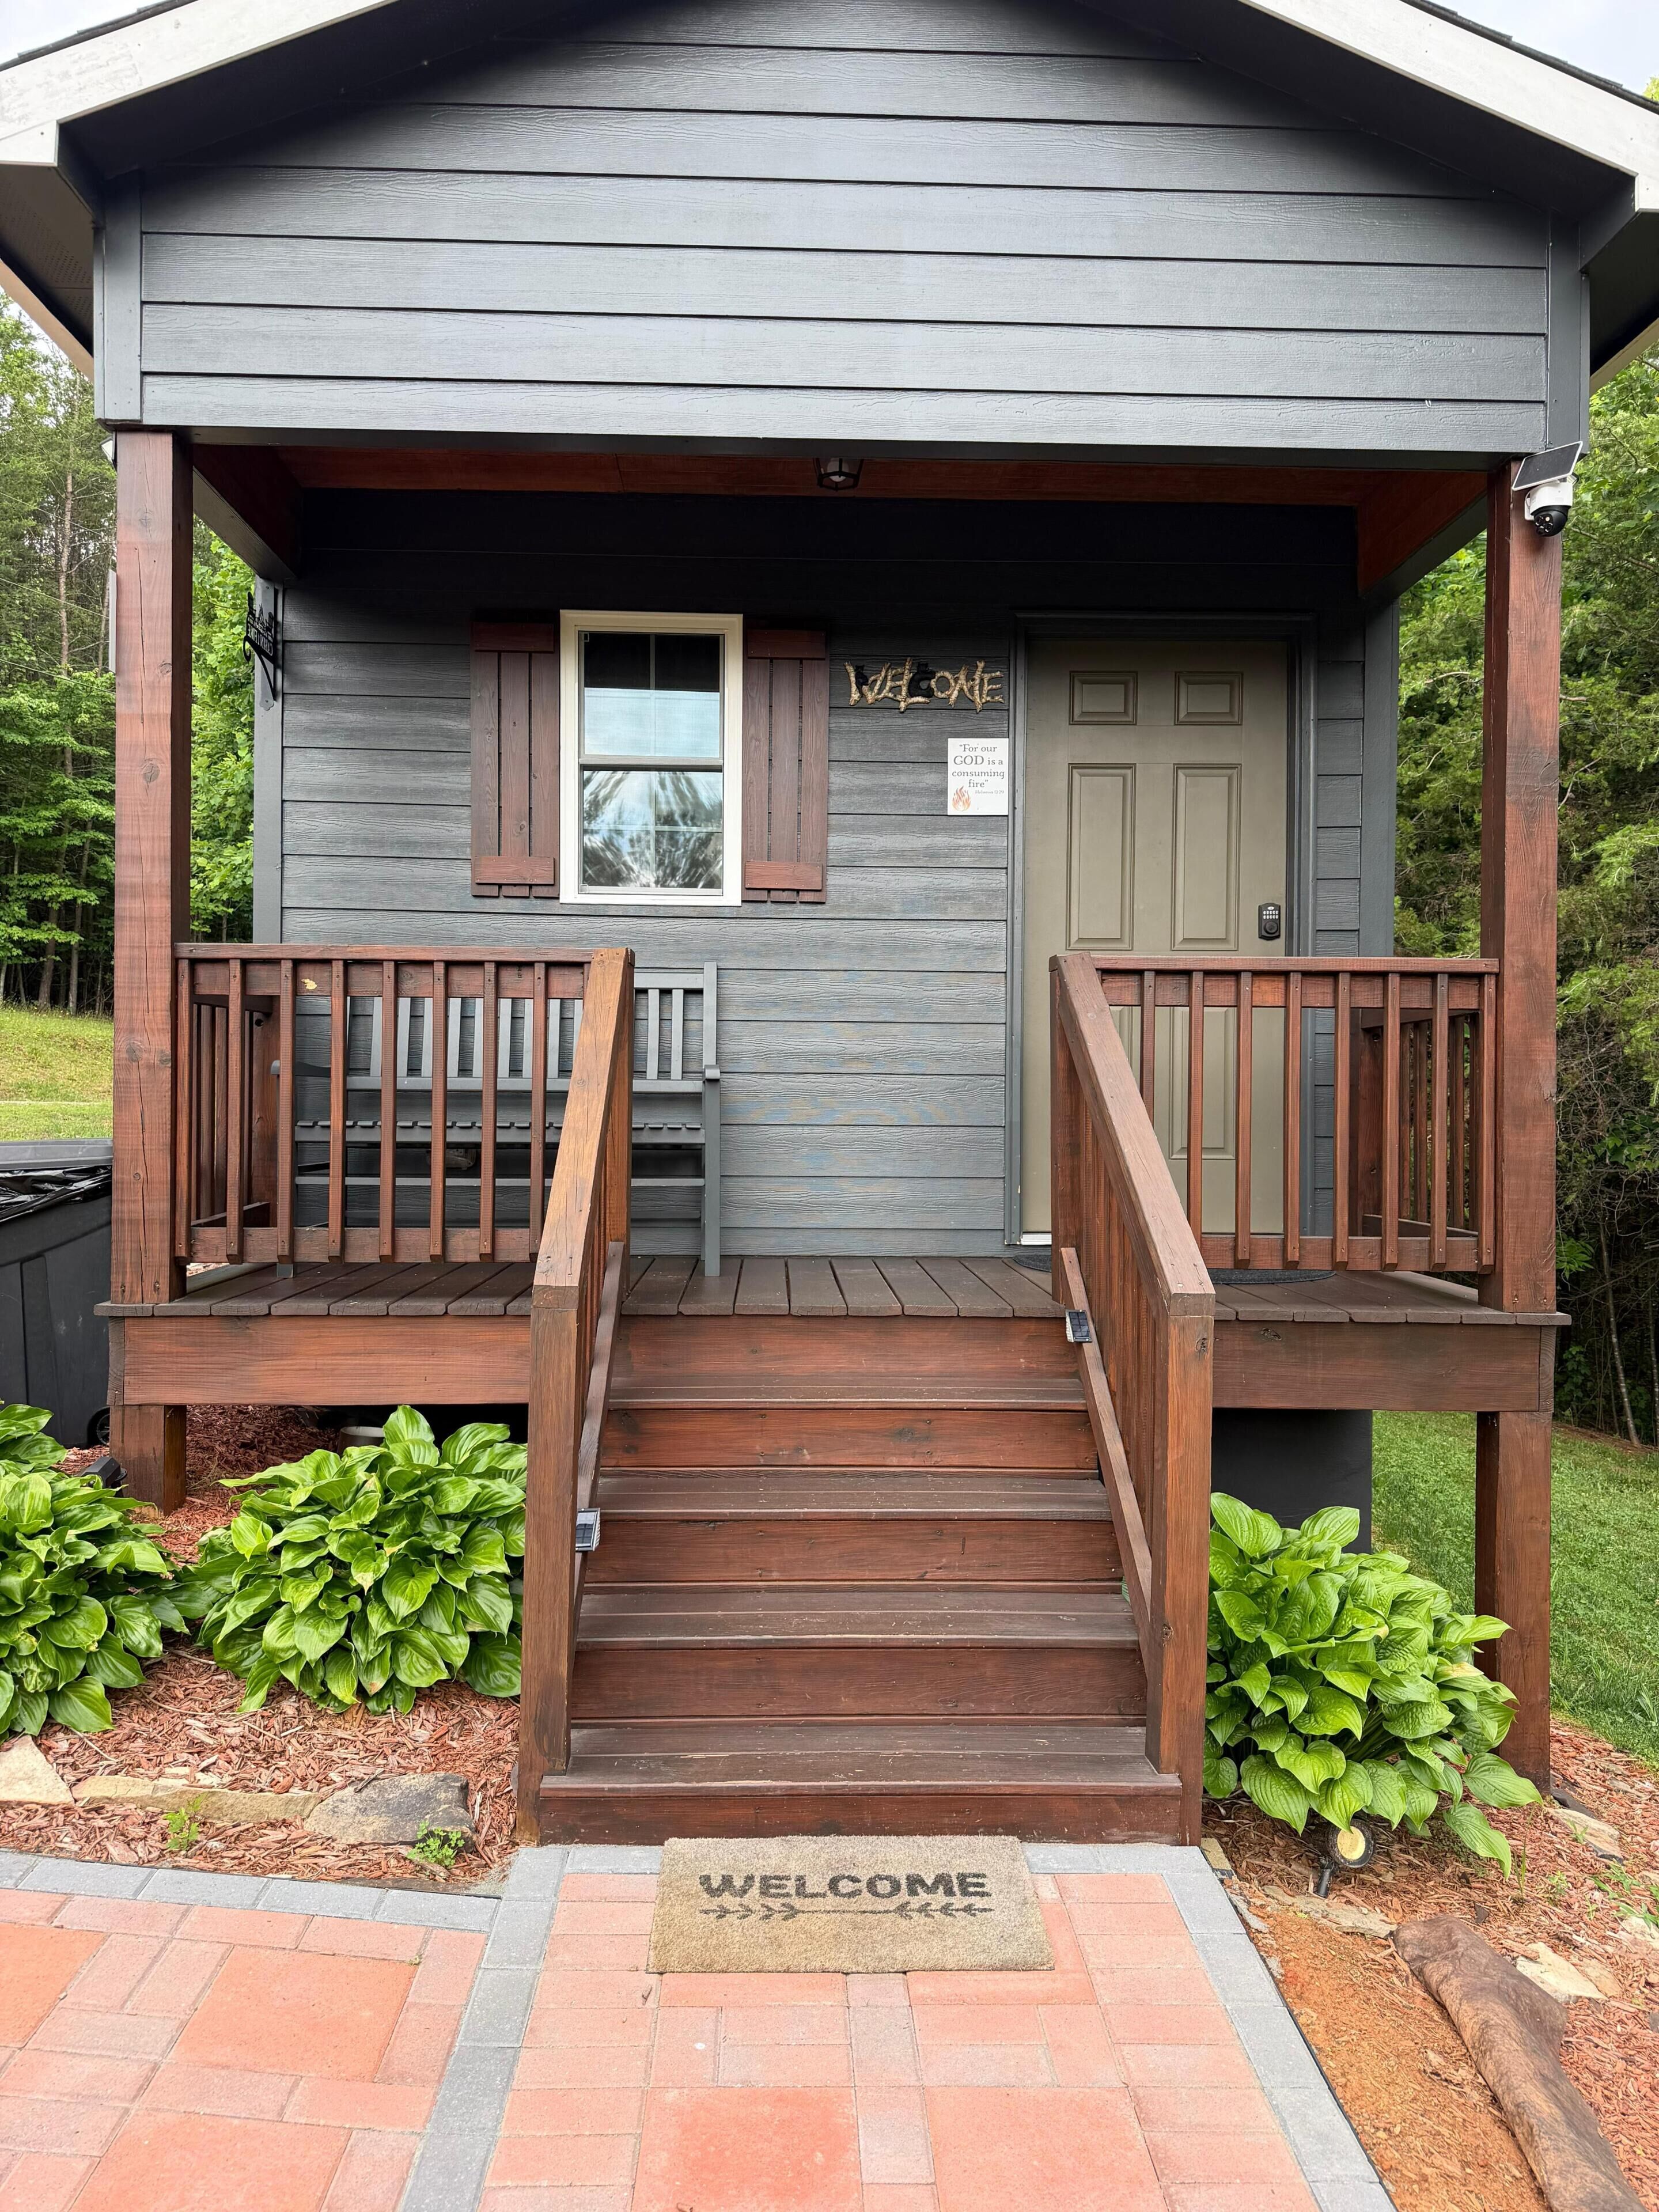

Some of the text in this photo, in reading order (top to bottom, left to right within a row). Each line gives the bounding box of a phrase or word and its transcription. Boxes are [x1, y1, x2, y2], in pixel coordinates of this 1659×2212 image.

[843, 657, 1004, 714] WELCOME
[953, 755, 984, 766] GOD
[987, 757, 995, 766] is
[952, 769, 1005, 779] consuming
[698, 1872, 993, 1899] WELCOME
